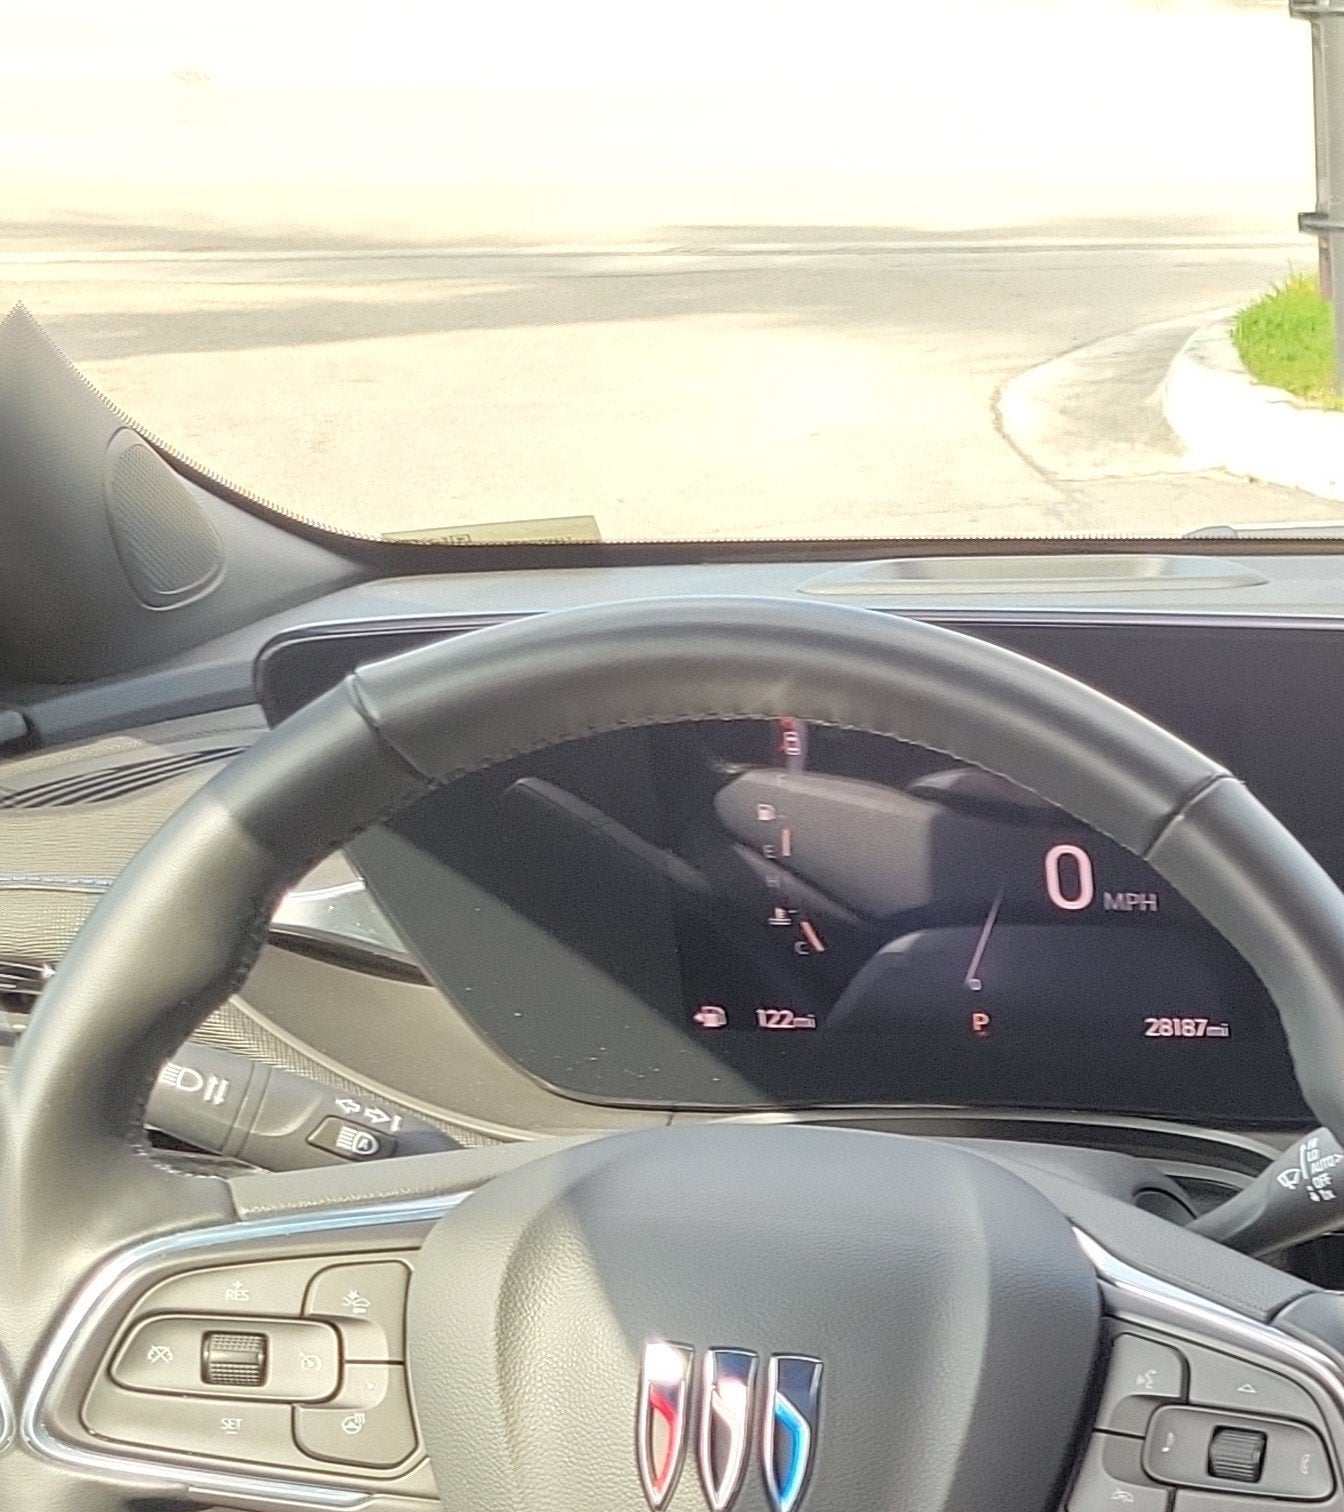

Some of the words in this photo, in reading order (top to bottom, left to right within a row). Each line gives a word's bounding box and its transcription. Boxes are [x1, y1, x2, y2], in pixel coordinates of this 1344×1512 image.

[1045, 844, 1094, 910] 0
[1103, 892, 1158, 911] MPH
[973, 1013, 990, 1031] P
[225, 1288, 250, 1302] RES
[220, 1418, 244, 1431] SET
